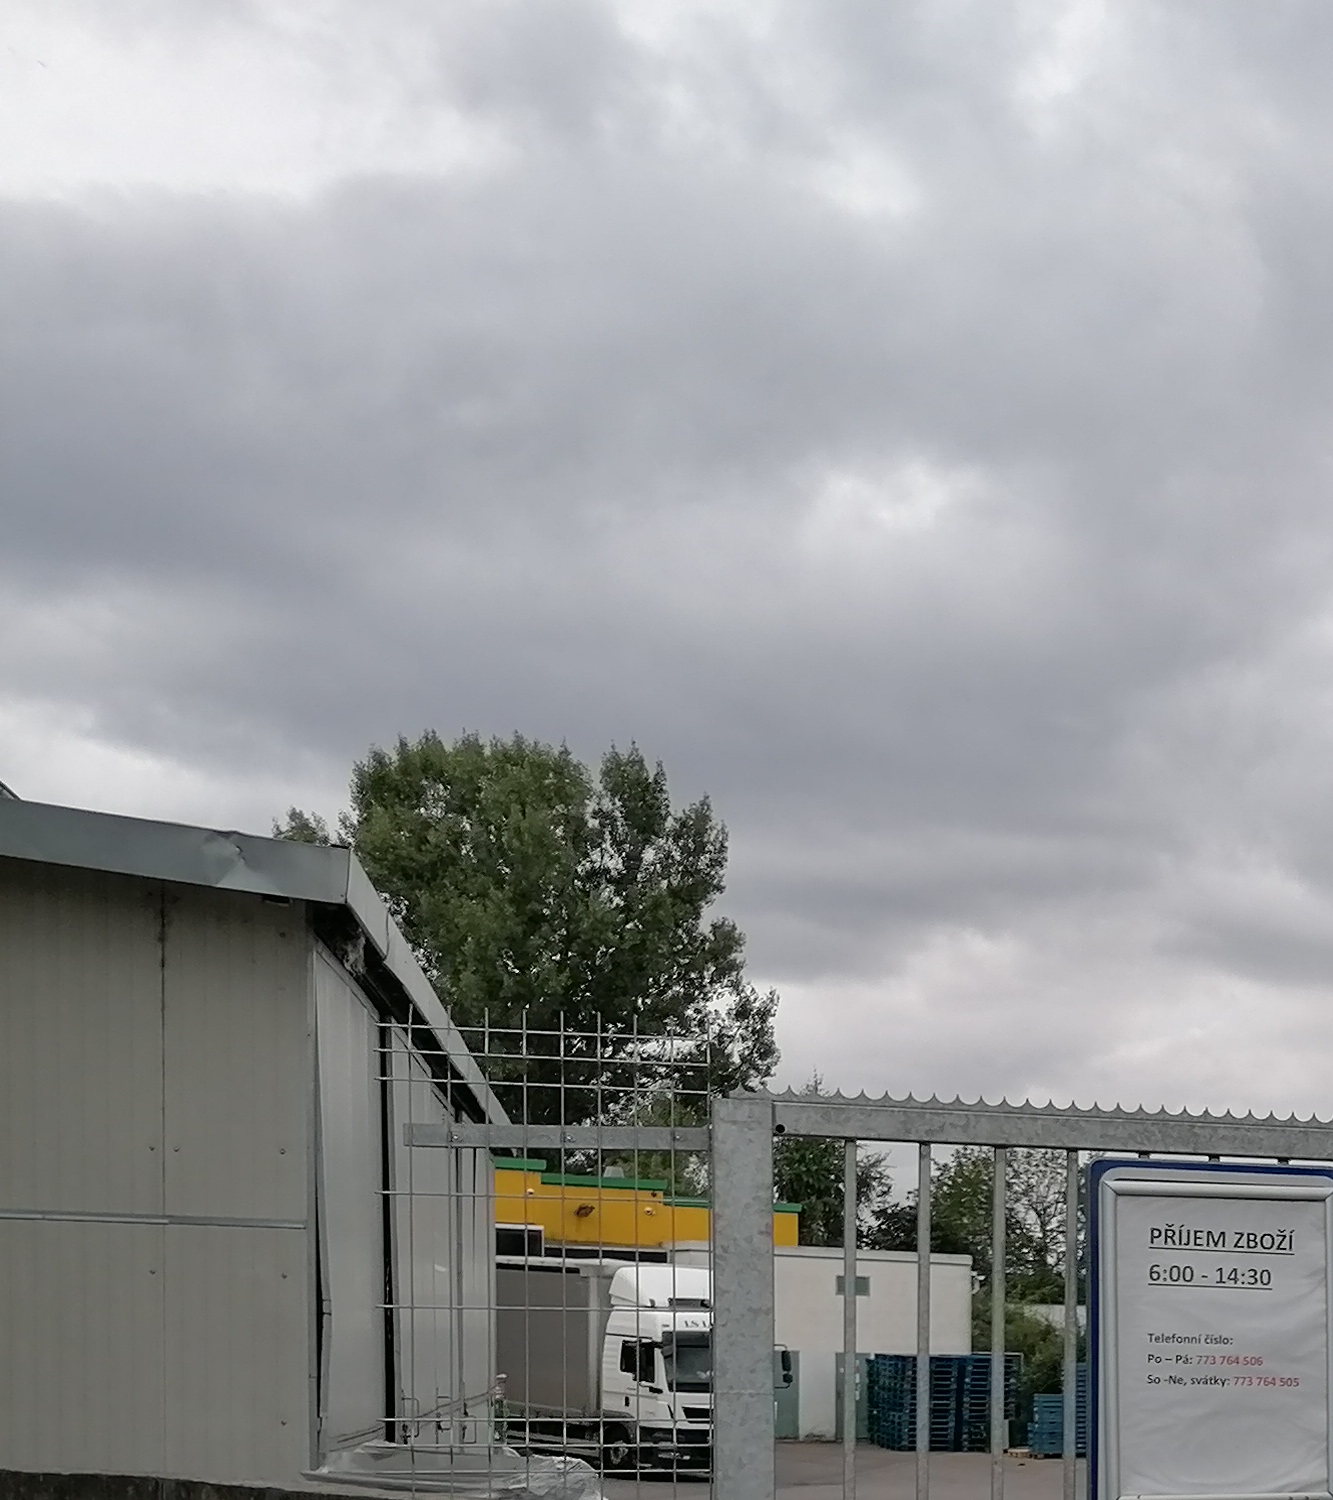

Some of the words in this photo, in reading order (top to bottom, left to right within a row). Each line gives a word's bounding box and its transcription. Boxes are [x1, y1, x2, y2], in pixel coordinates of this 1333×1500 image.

[1150, 1223, 1226, 1248] PŘÍJEM
[1233, 1229, 1295, 1251] ZBOŽÍ
[1149, 1264, 1194, 1282] 6:00
[1215, 1267, 1271, 1285] 14:30
[1148, 1333, 1201, 1345] Telefonní
[1204, 1334, 1234, 1345] číslo:
[1147, 1354, 1162, 1364] Po
[1175, 1354, 1193, 1365] Pá:
[1196, 1355, 1217, 1366] 773
[1219, 1355, 1240, 1366] 764
[1243, 1356, 1264, 1367] 506
[1146, 1374, 1161, 1385] So
[1163, 1375, 1188, 1387] -Ne,
[1190, 1374, 1231, 1388] svátky:
[1233, 1376, 1254, 1387] 773
[1256, 1376, 1277, 1387] 764
[1279, 1377, 1300, 1388] 505
